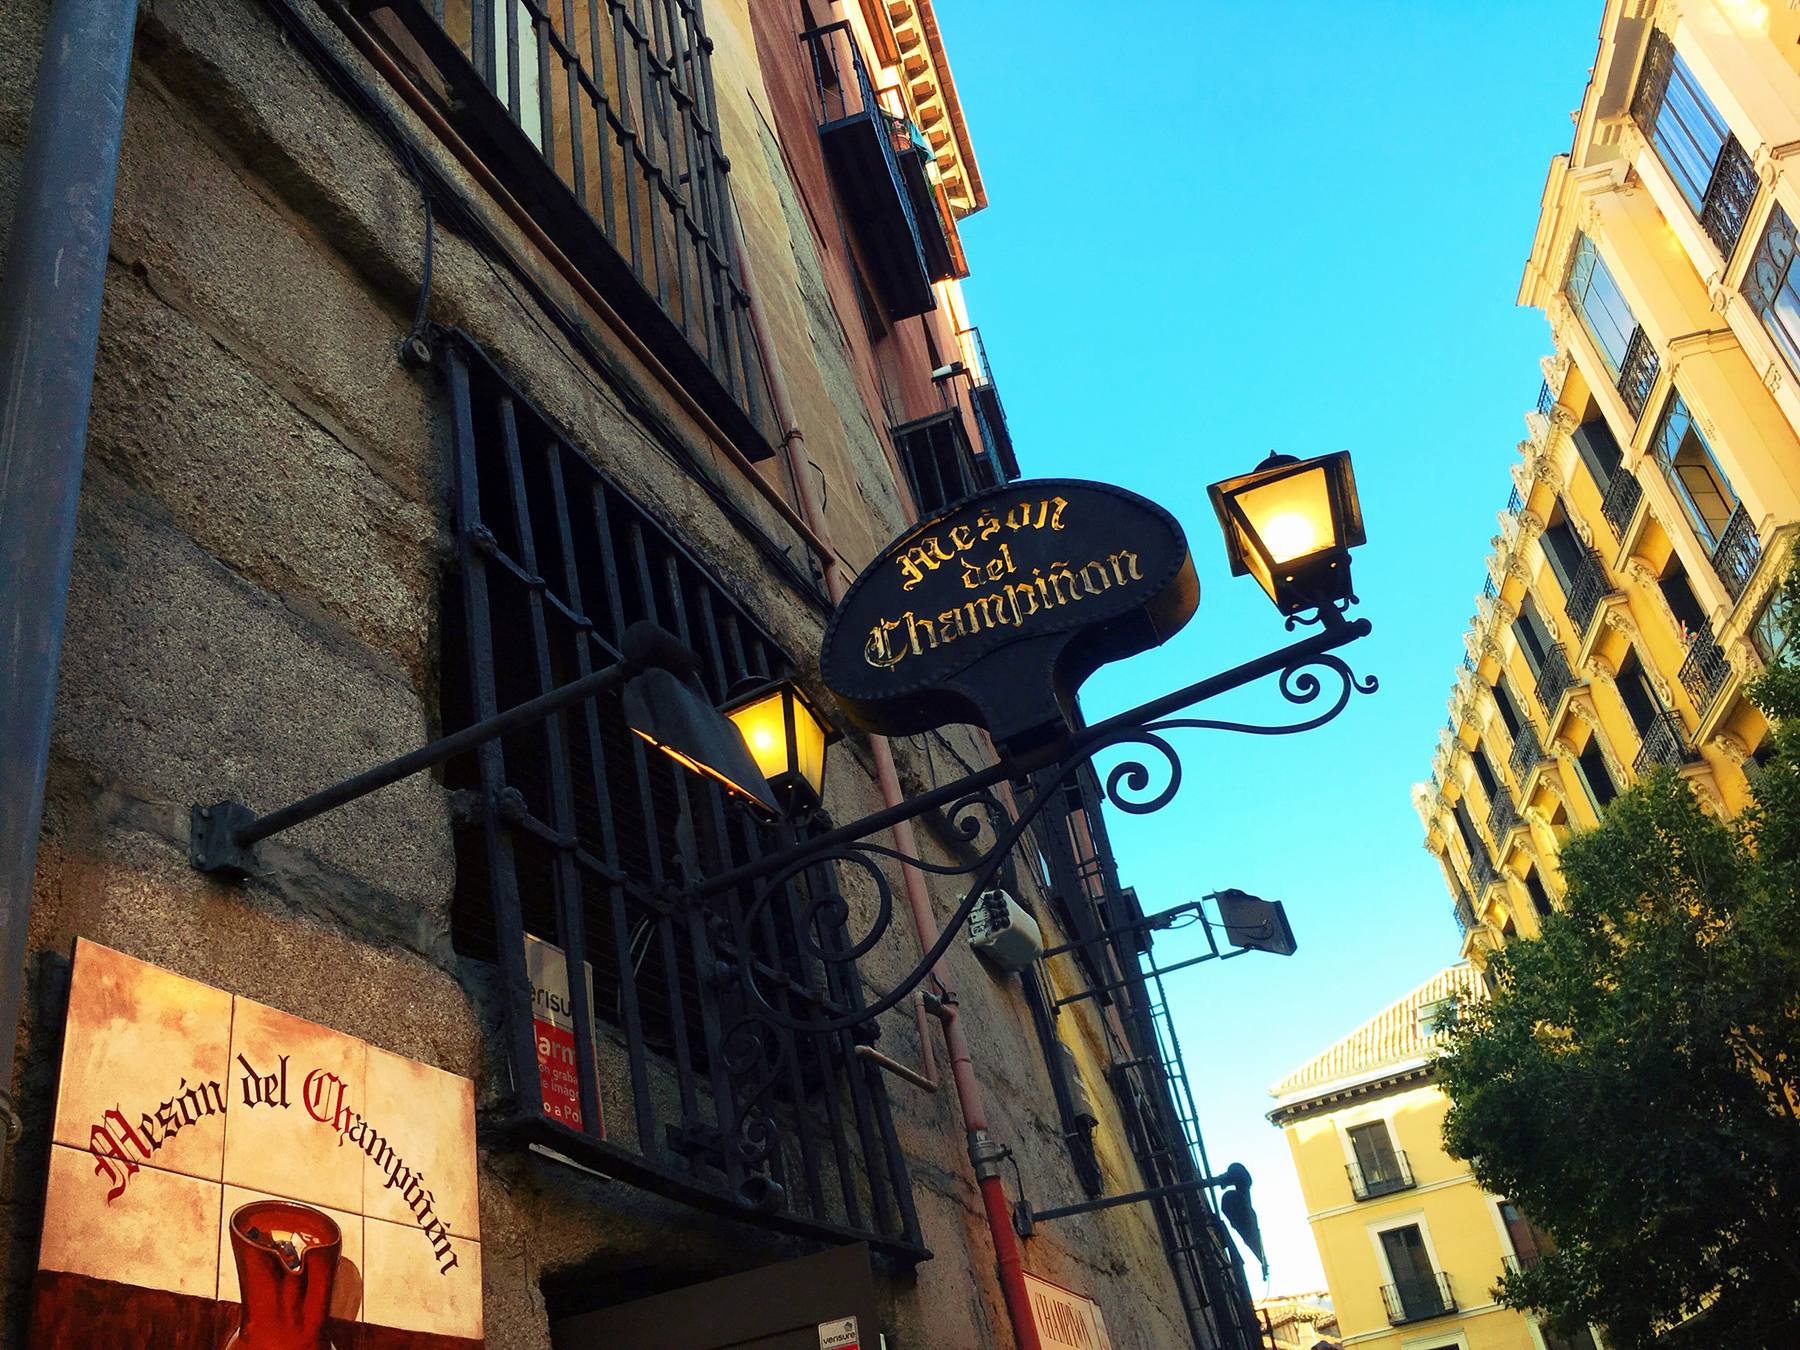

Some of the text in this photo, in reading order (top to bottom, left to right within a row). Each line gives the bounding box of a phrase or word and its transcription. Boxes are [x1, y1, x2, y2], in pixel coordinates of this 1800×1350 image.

[961, 543, 1017, 589] del
[864, 550, 1144, 671] Champiñon
[531, 984, 571, 1017] erisu
[89, 1053, 459, 1276] Mesón del Champiñón
[823, 1331, 856, 1345] verisure
